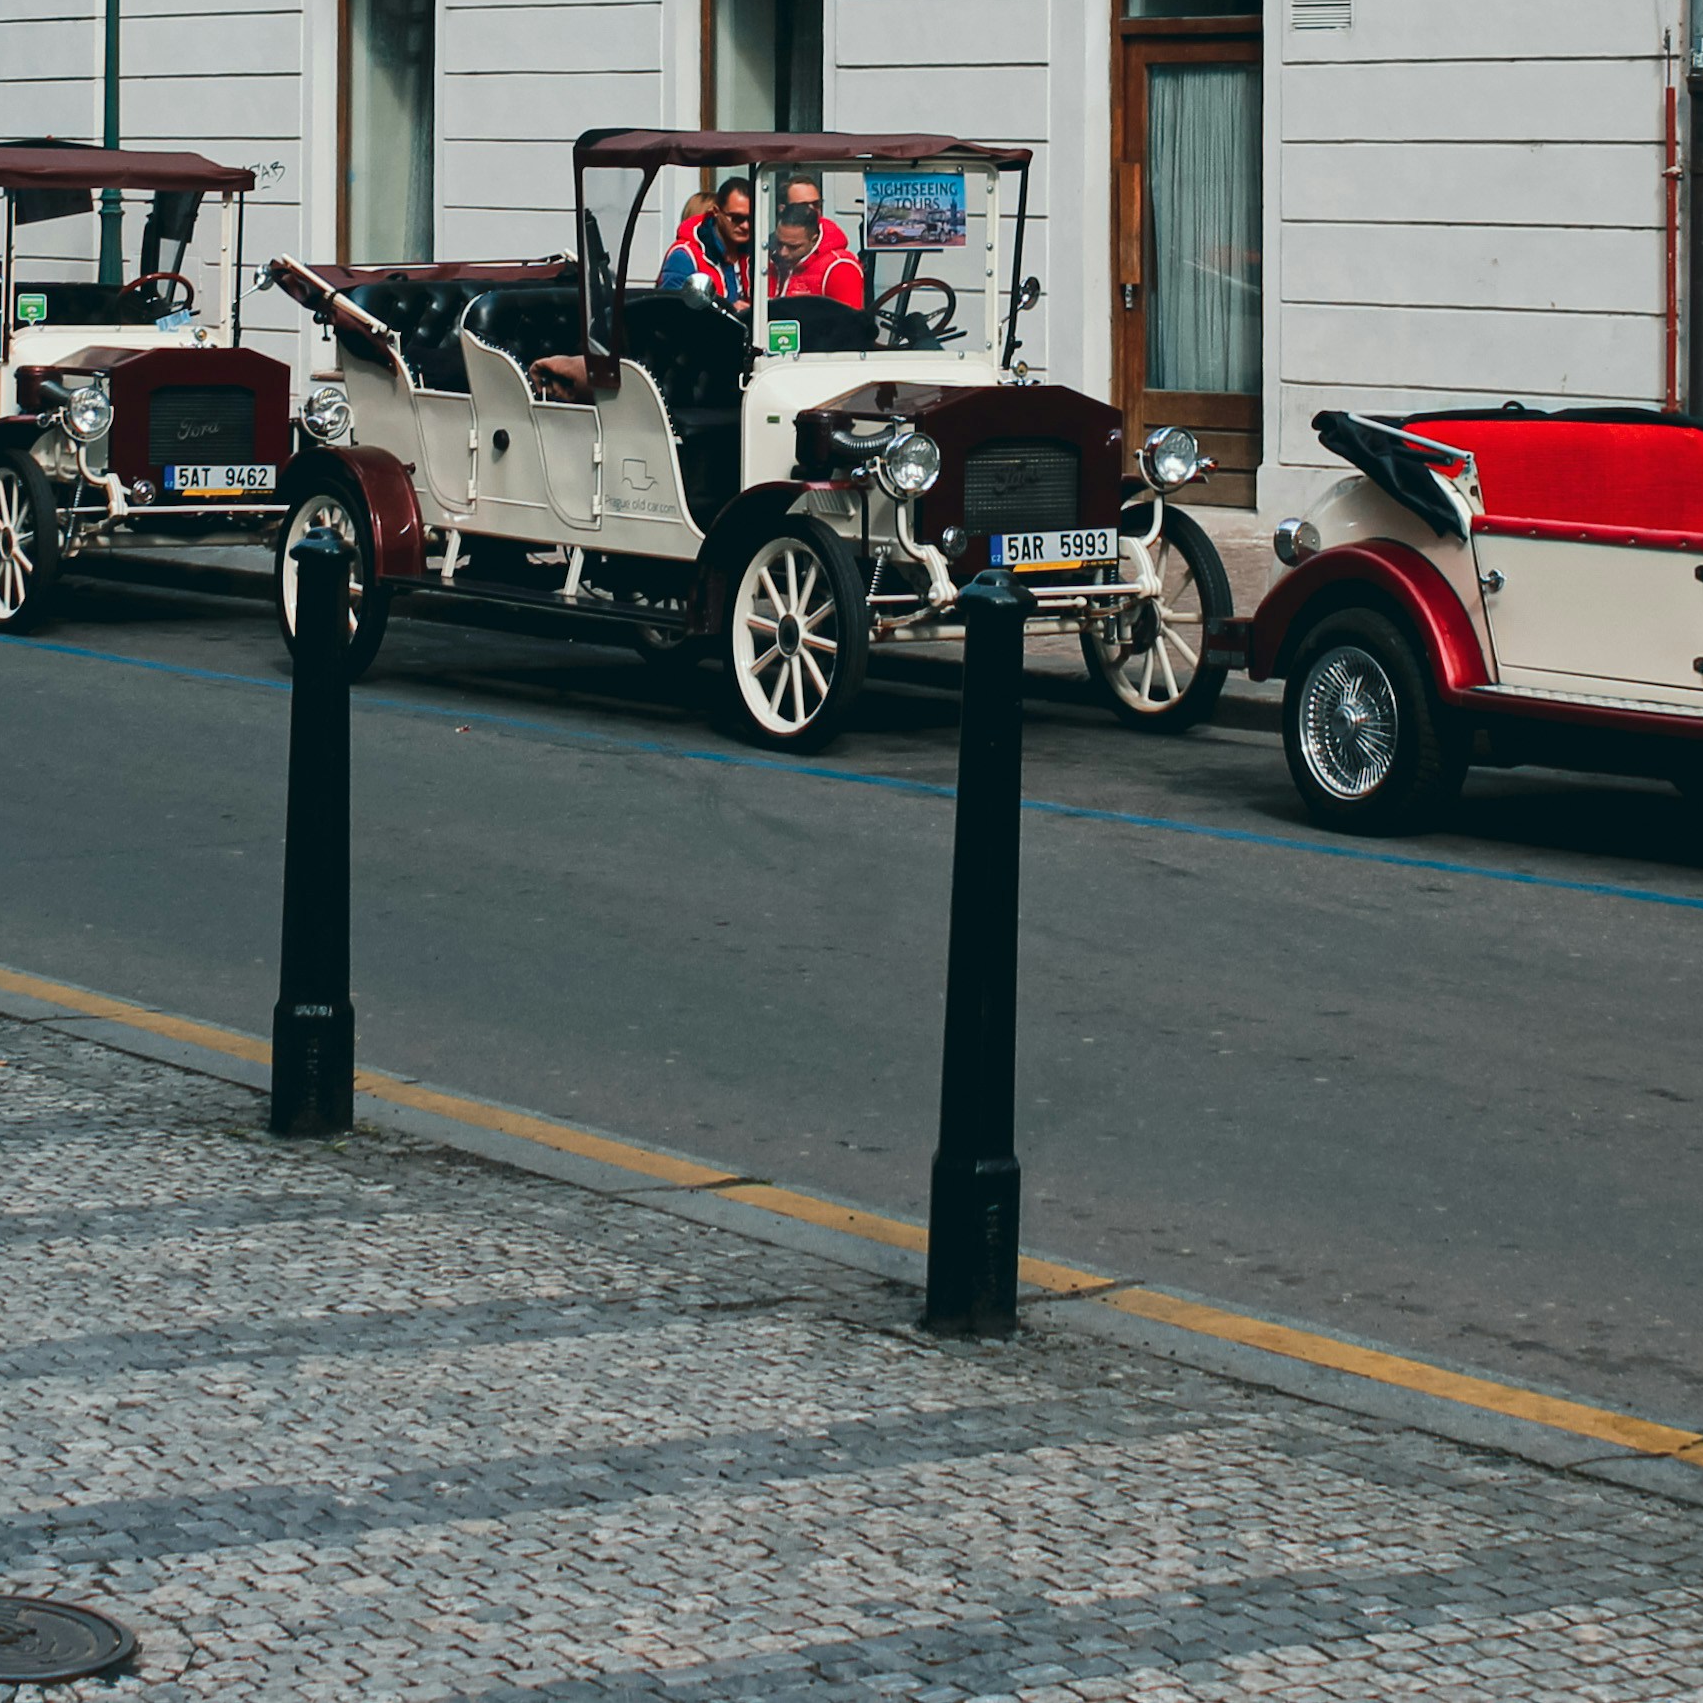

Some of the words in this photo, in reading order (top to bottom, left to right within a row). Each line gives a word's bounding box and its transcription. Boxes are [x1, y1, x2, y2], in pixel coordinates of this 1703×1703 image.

[871, 182, 958, 198] SIGHTSEEING
[895, 197, 941, 211] TOURS
[178, 467, 211, 487] 5AT
[224, 466, 269, 487] 9462
[604, 493, 631, 511] Prague
[1007, 535, 1044, 562] 5AR
[1059, 531, 1109, 558] 5993
